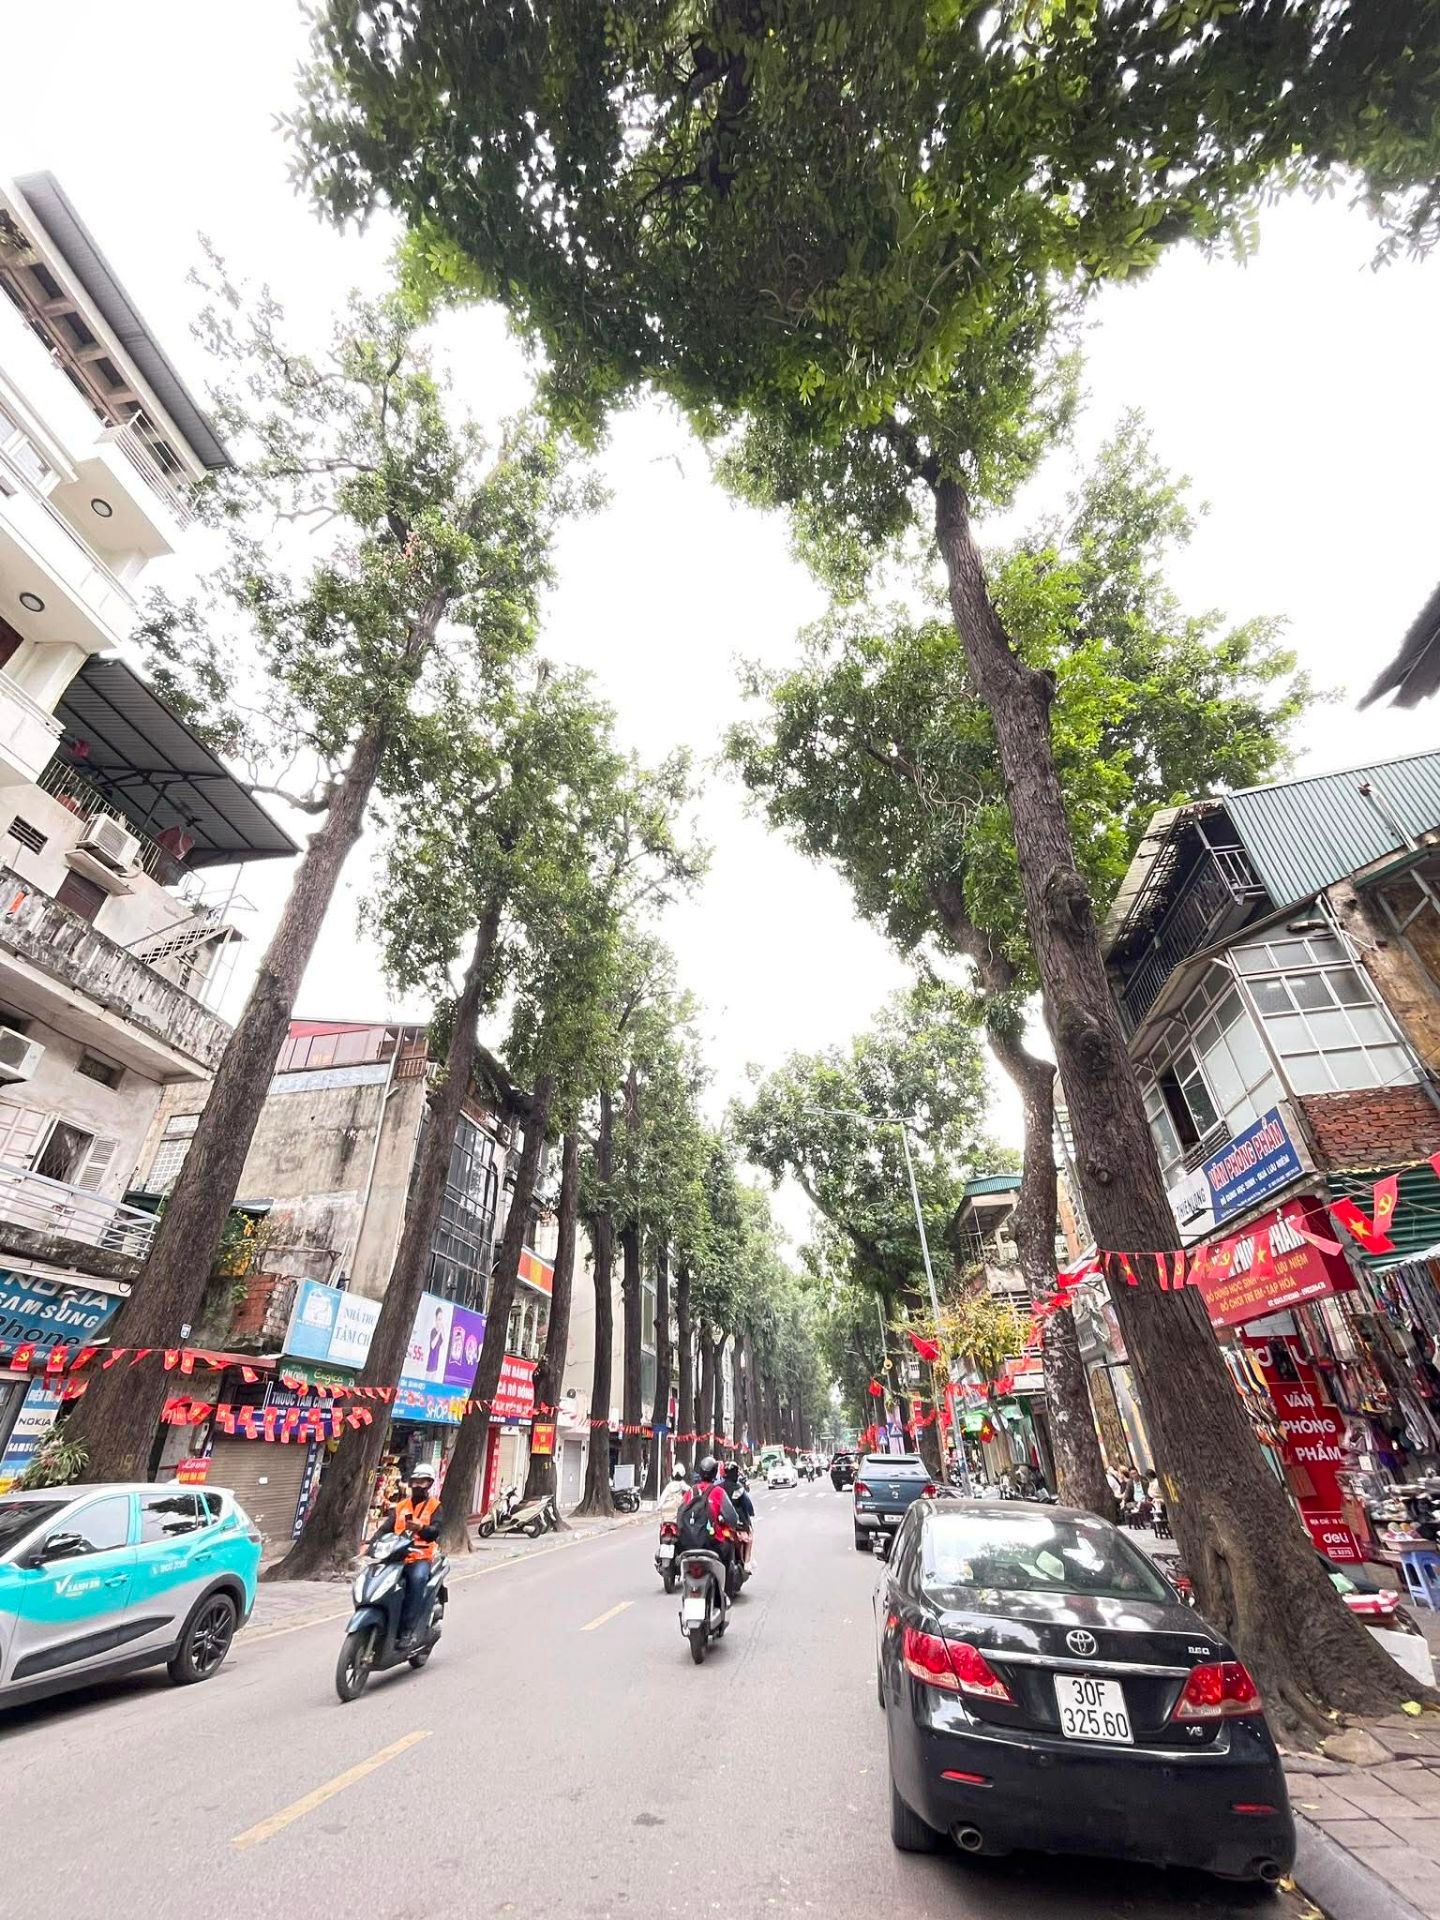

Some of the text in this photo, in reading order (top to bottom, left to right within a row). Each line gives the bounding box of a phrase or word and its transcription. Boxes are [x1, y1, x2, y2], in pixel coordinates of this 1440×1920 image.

[1252, 1117, 1285, 1160] PHẨM
[1283, 1391, 1315, 1408] VĂN
[1280, 1416, 1336, 1434] PHÒNG
[1296, 1439, 1342, 1462] PHẨM
[1322, 1532, 1350, 1544] deli
[1072, 1680, 1105, 1707] 30F
[1064, 1707, 1129, 1738] 325.60
